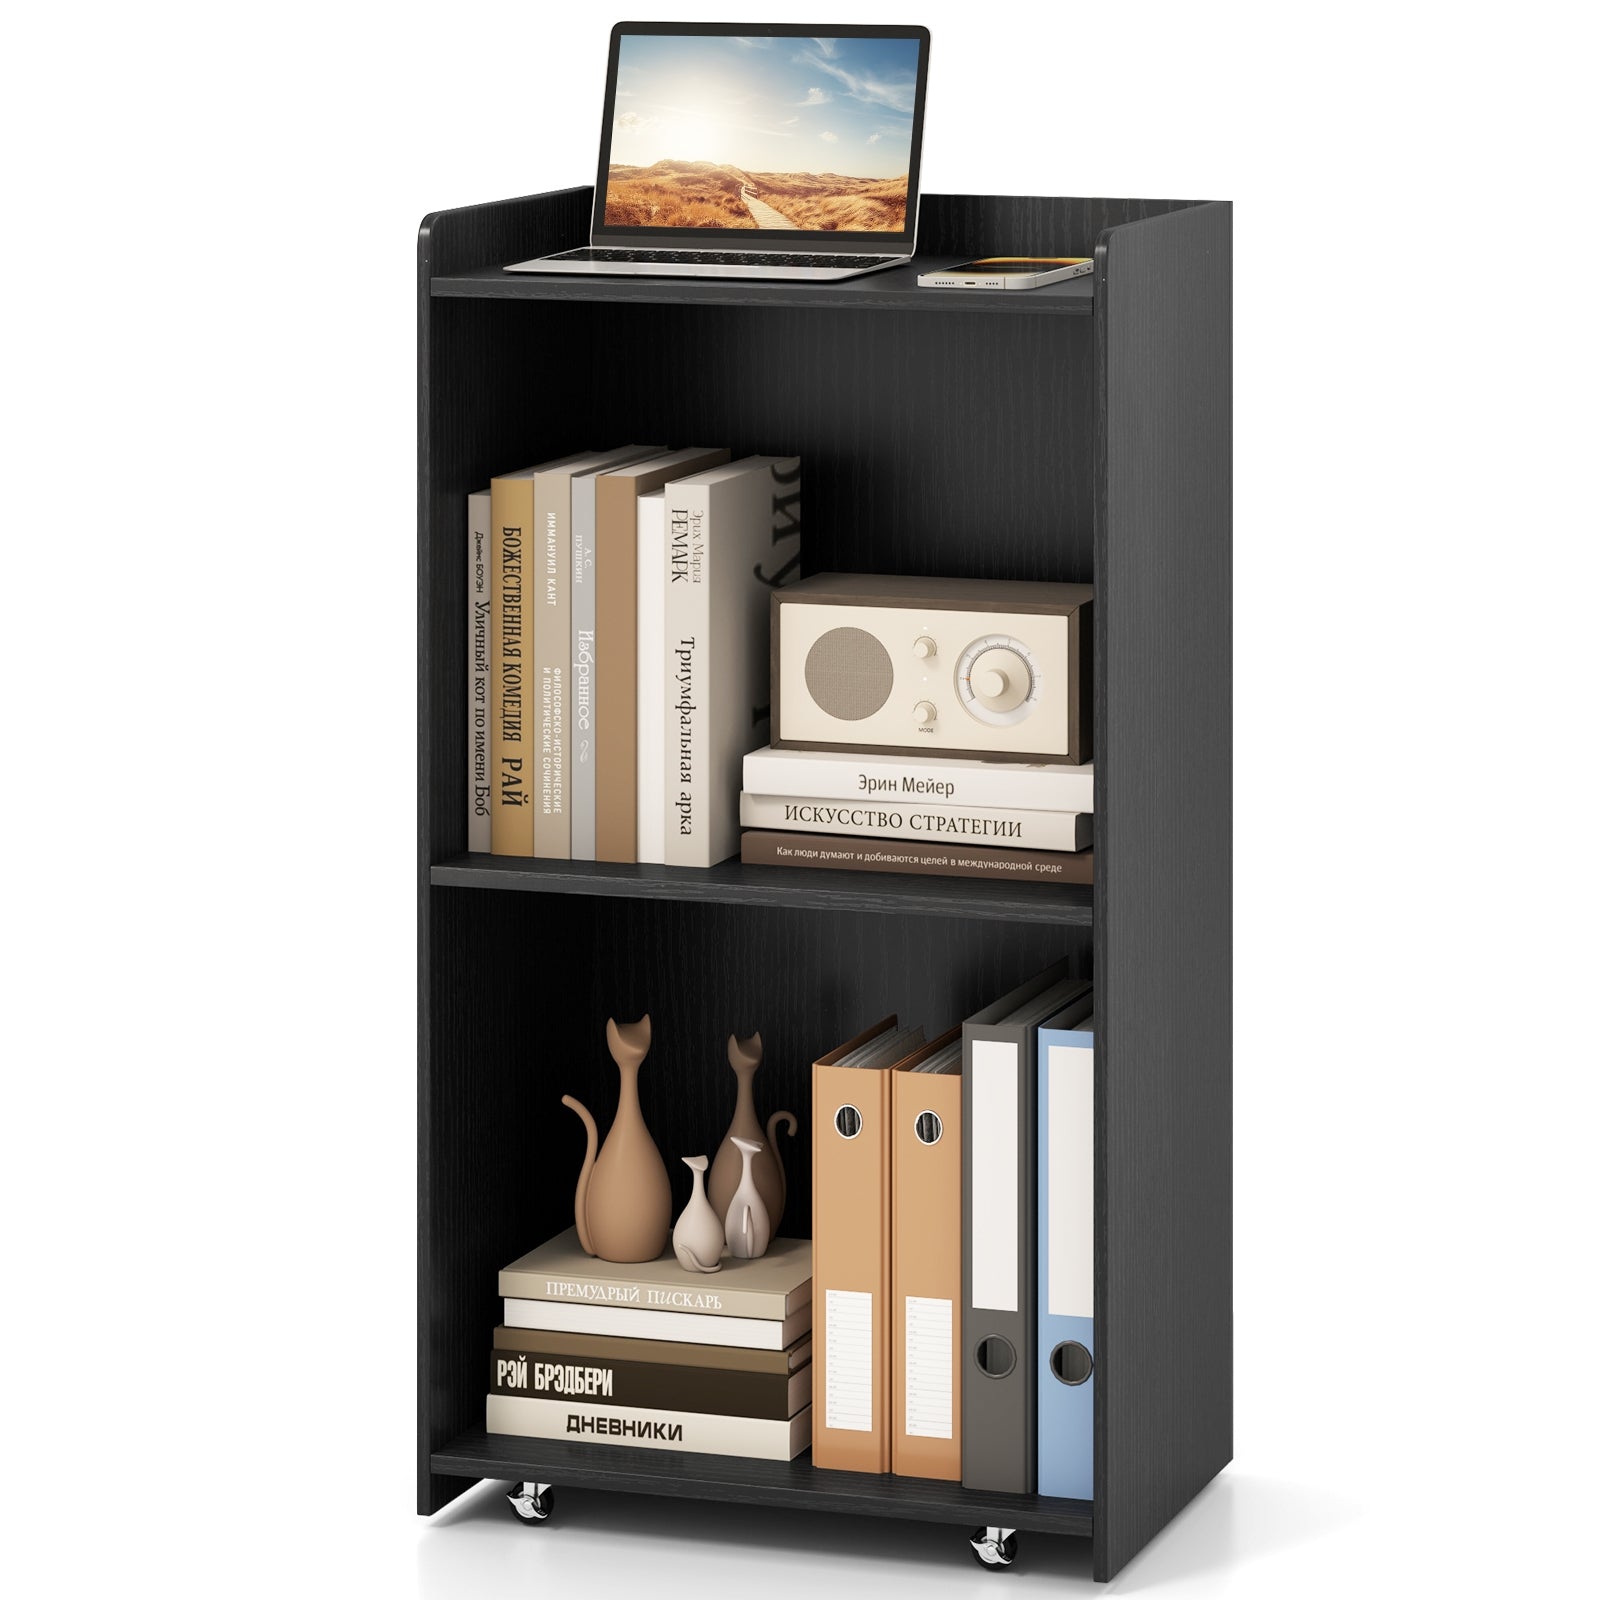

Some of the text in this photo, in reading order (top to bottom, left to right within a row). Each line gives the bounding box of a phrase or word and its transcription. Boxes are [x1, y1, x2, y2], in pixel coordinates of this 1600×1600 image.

[475, 531, 484, 594] Джеймс БОУЭН
[547, 512, 557, 607] ИММАНУИЛ КАНТ
[575, 534, 583, 584] ПУШКИН
[672, 510, 688, 582] РЕМАРК
[690, 511, 704, 583] Эрих Мария
[500, 527, 528, 806] БОЖЕСТВЕННАЯ КОМЕДИЯ РАЙ
[574, 630, 594, 729] Избранное
[475, 601, 490, 816] Уличный кот по имени Боб
[543, 677, 552, 754] ПОЛИТИЧЕСКИЕ
[554, 667, 562, 814] ФИЛОСОФСКО-ИСТОРИЧЕСКИЕ
[675, 637, 696, 836] Триумфальная арка
[543, 757, 552, 814] СОЧИНЕНИЯ
[858, 773, 955, 799] Эрин Мейер
[784, 804, 1022, 839] ИСКУССТВО СТРАТЕГИИ
[777, 846, 793, 856] Как
[794, 849, 819, 859] люди
[820, 850, 855, 860] думают
[864, 852, 918, 863] добиваются
[921, 856, 948, 866] целей
[950, 858, 957, 866] в
[958, 859, 1033, 871] международной
[1035, 863, 1063, 874] среде
[546, 1281, 641, 1303] ПРЕМУДРЫЙ
[498, 1356, 613, 1398] РЭЙ БРЭДБЕРИ
[566, 1414, 683, 1442] ДНЕВНИКИ
